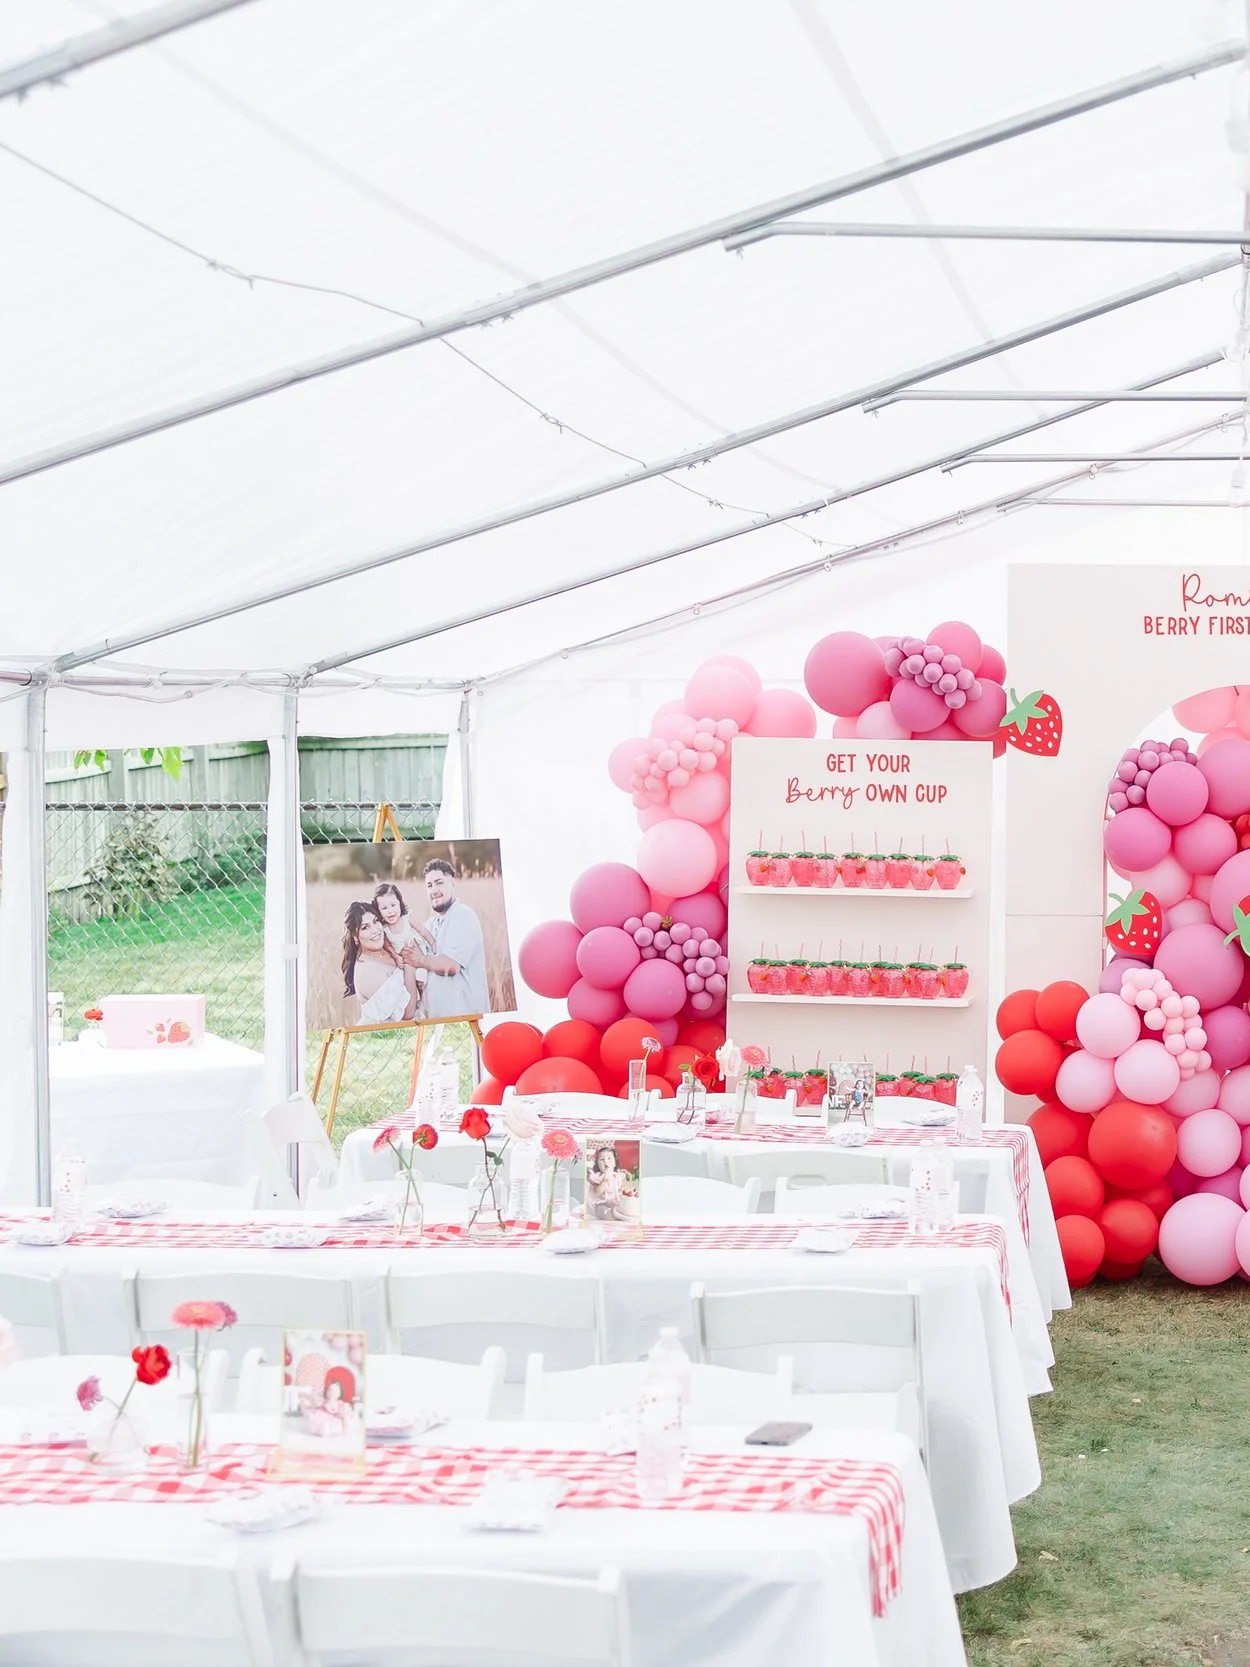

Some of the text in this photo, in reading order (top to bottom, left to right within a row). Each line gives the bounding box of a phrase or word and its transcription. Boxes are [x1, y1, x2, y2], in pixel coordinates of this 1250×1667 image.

[1144, 616, 1200, 635] BERRY
[826, 753, 911, 773] GET YOUR
[785, 777, 947, 809] Berry OWN CUP
